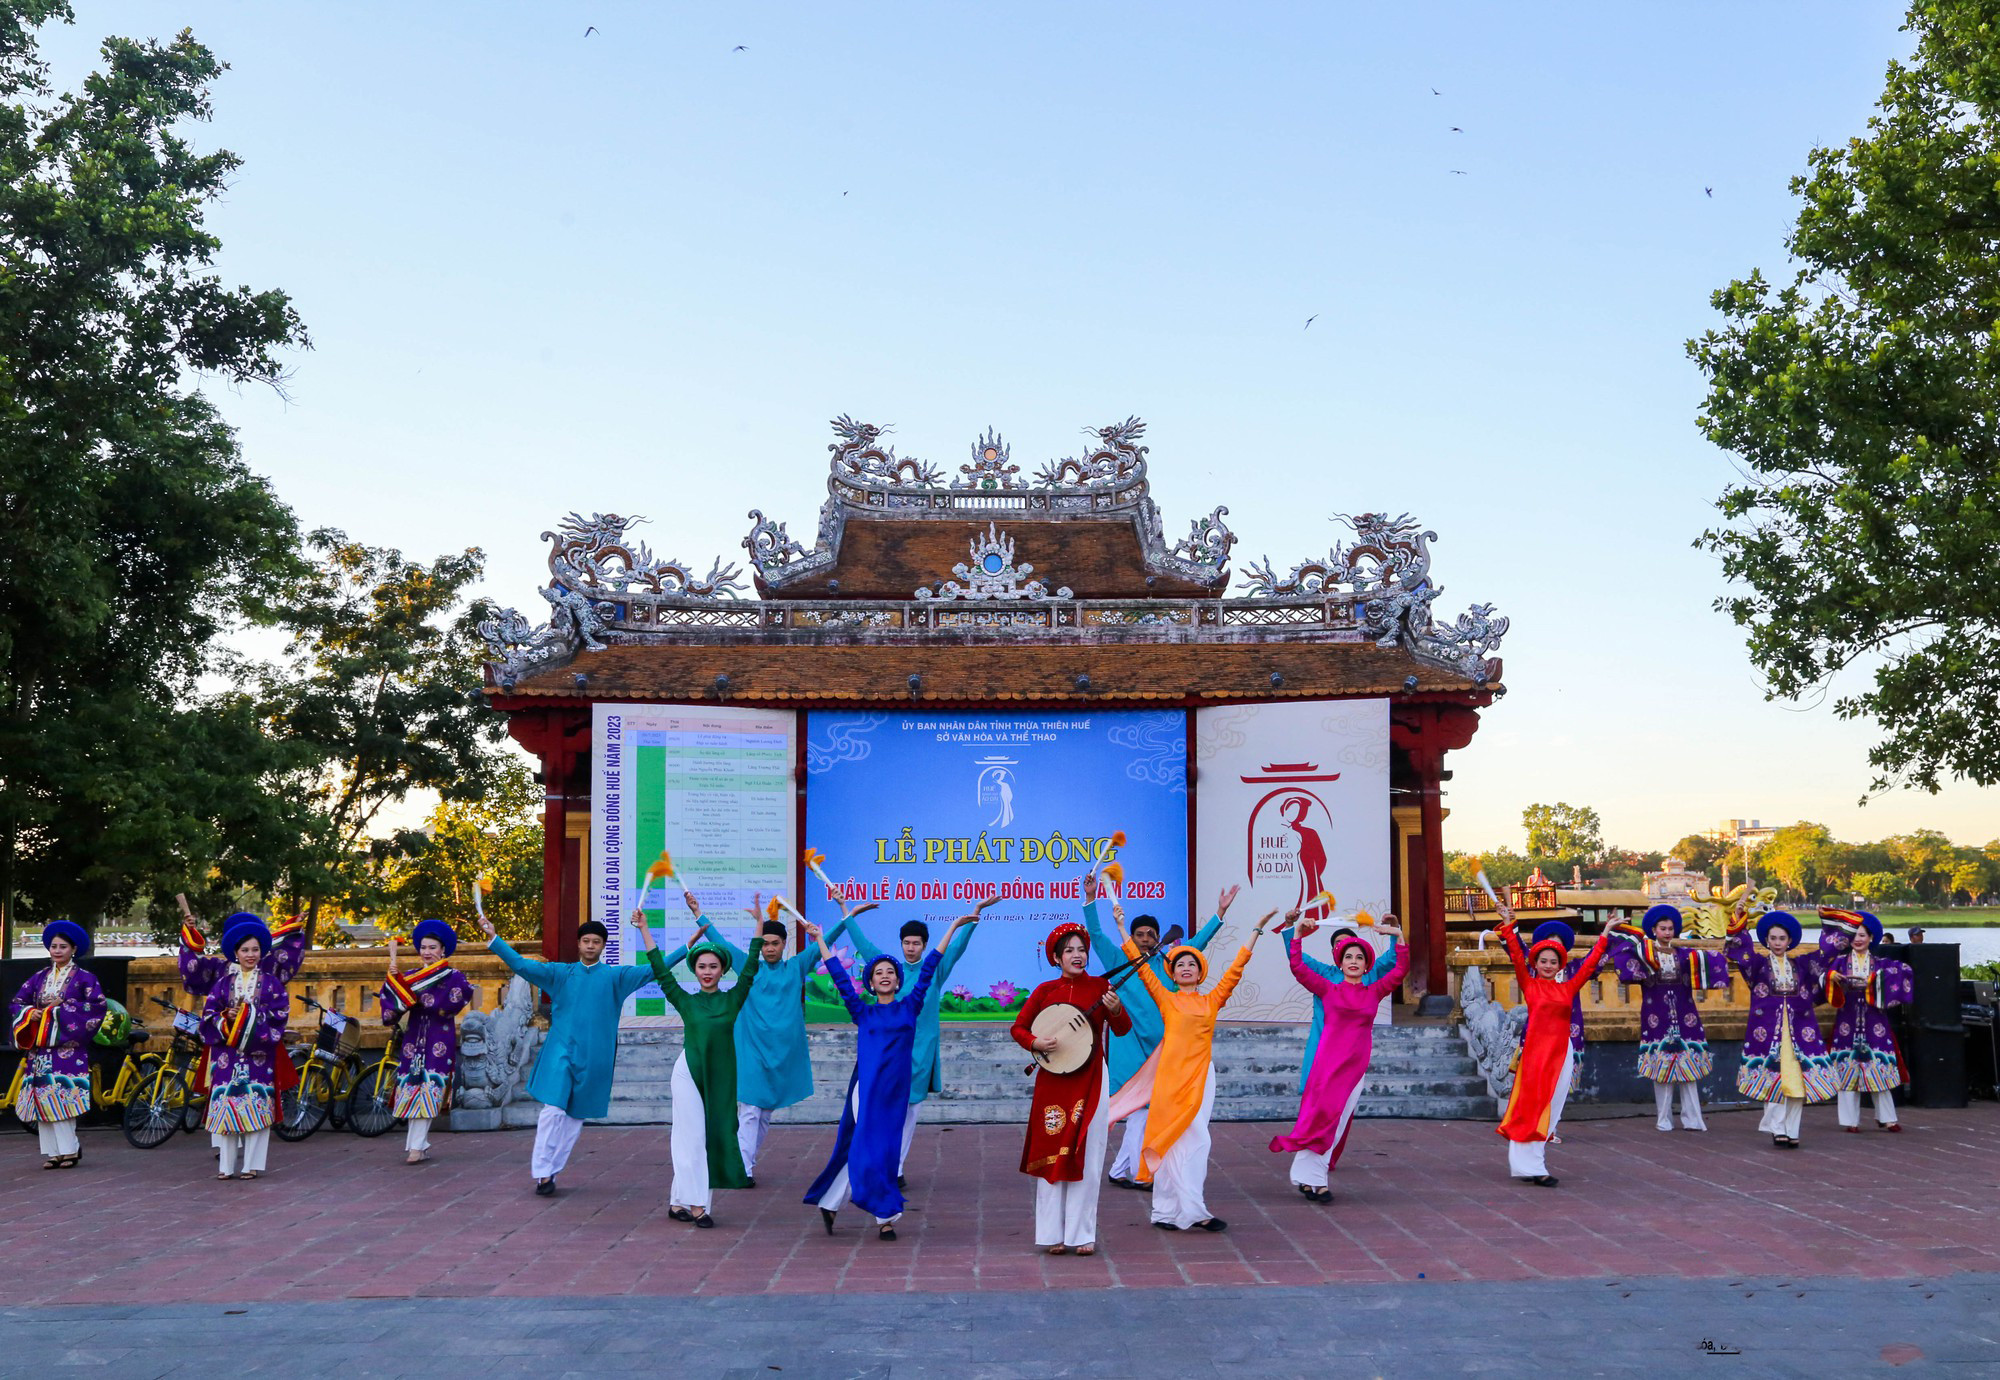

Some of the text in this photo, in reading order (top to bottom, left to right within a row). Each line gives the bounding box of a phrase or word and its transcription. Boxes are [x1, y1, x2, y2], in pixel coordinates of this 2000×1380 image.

[607, 715, 621, 741] 2023
[902, 719, 1091, 730] ỦY BAN NHÂN DÂN TỈNH THỪA THIÊN HUẾ
[936, 730, 1057, 742] SỞ VĂN HÓA VÀ THỂ THAO
[603, 743, 621, 767] NĂM
[602, 770, 621, 790] HUẾ
[601, 793, 621, 822] ĐỒNG
[603, 825, 624, 854] CỘNG
[875, 827, 1118, 869] LỄ PHÁT ĐỘNG
[1261, 832, 1288, 848] HUẾ
[1280, 851, 1294, 860] ĐÔ
[603, 856, 621, 875] DÀI
[1256, 860, 1294, 873] ÁO DÀI
[602, 877, 621, 892] ÁO
[872, 876, 889, 900] LỄ
[895, 879, 916, 900] ÁO
[922, 879, 947, 900] DÀI
[953, 878, 996, 904] CỘNG
[1001, 876, 1044, 899] ĐỒNG
[1050, 875, 1082, 899] HUẾ
[1127, 881, 1165, 899] 2023
[601, 894, 621, 907] LỄ
[1028, 912, 1070, 921] 12/7/2023
